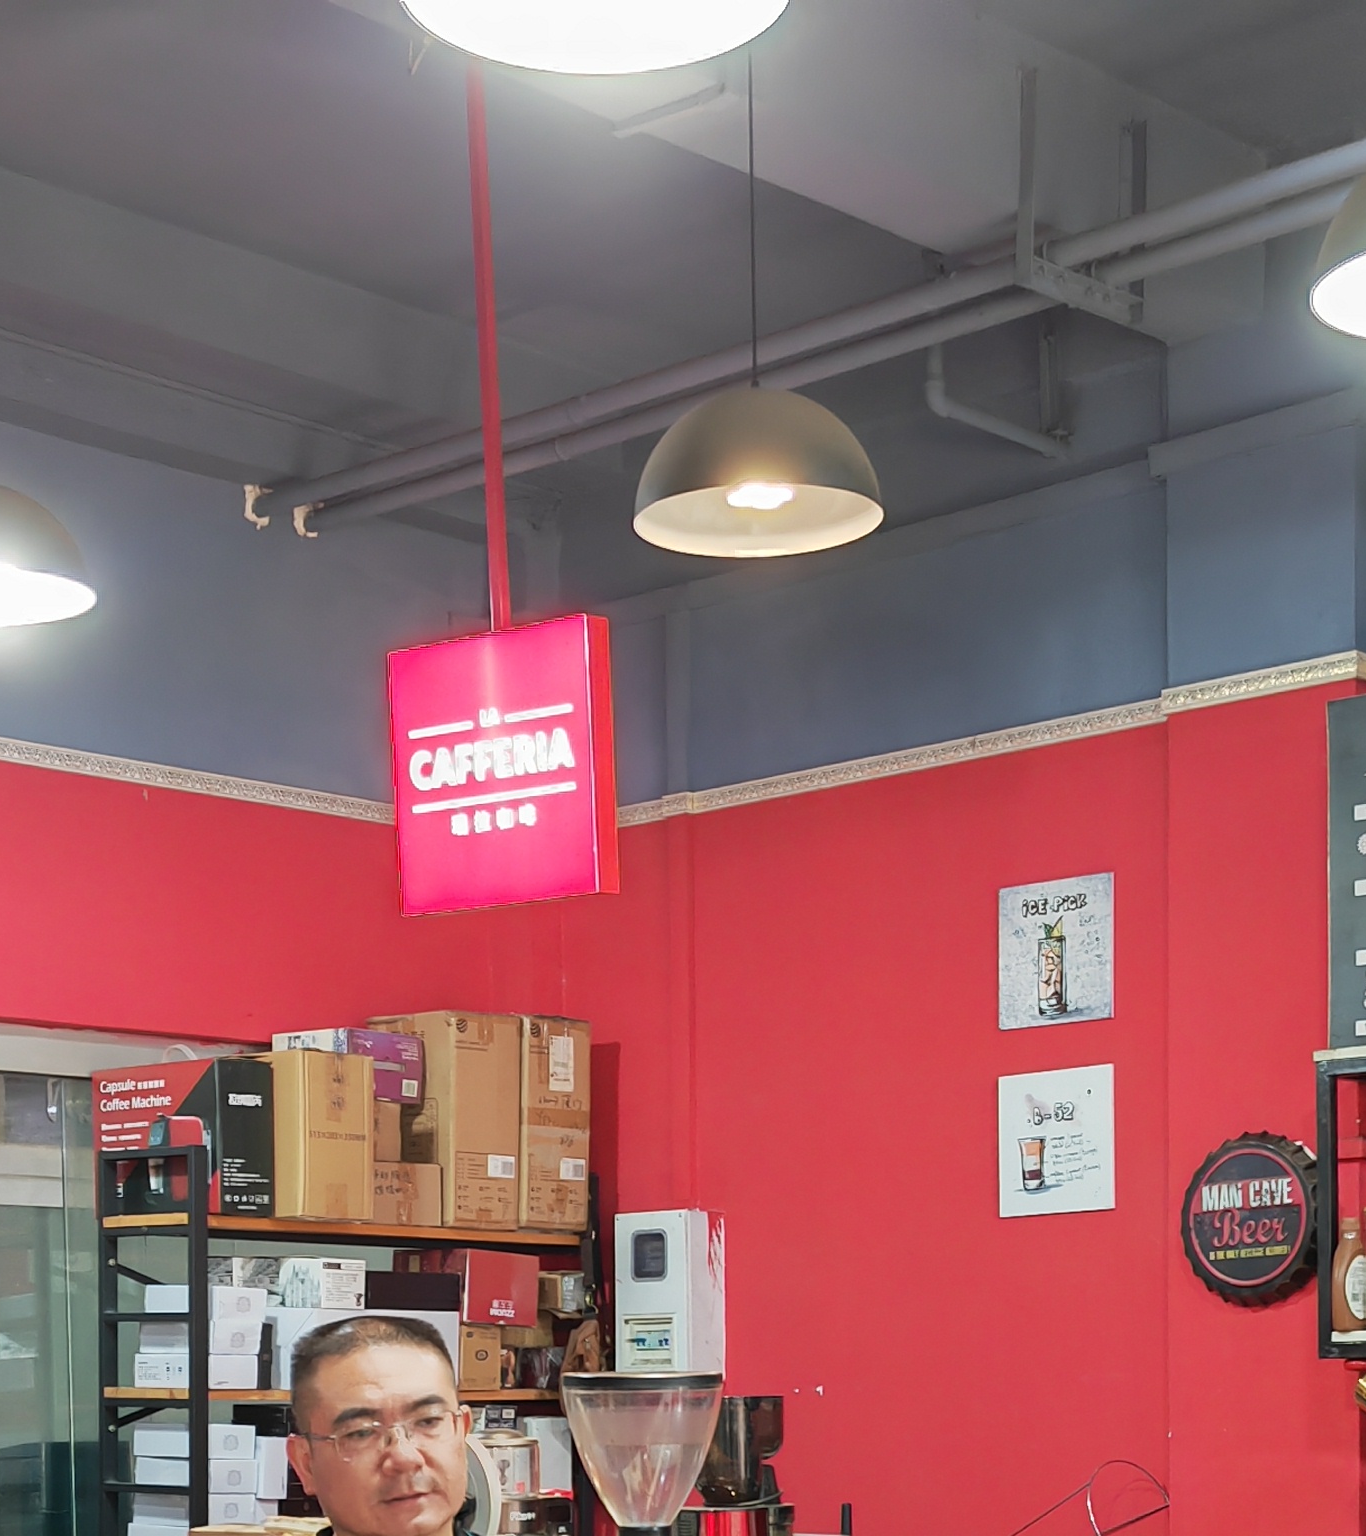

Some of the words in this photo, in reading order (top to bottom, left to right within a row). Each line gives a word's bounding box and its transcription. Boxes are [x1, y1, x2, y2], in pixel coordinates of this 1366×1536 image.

[409, 728, 575, 791] CAFFERIA
[100, 1079, 136, 1095] Capsule
[100, 1098, 130, 1112] Coffee
[131, 1094, 172, 1109] Machine
[1202, 1182, 1243, 1212] MAN
[1249, 1178, 1294, 1207] CAVE
[1212, 1208, 1288, 1248] Beer
